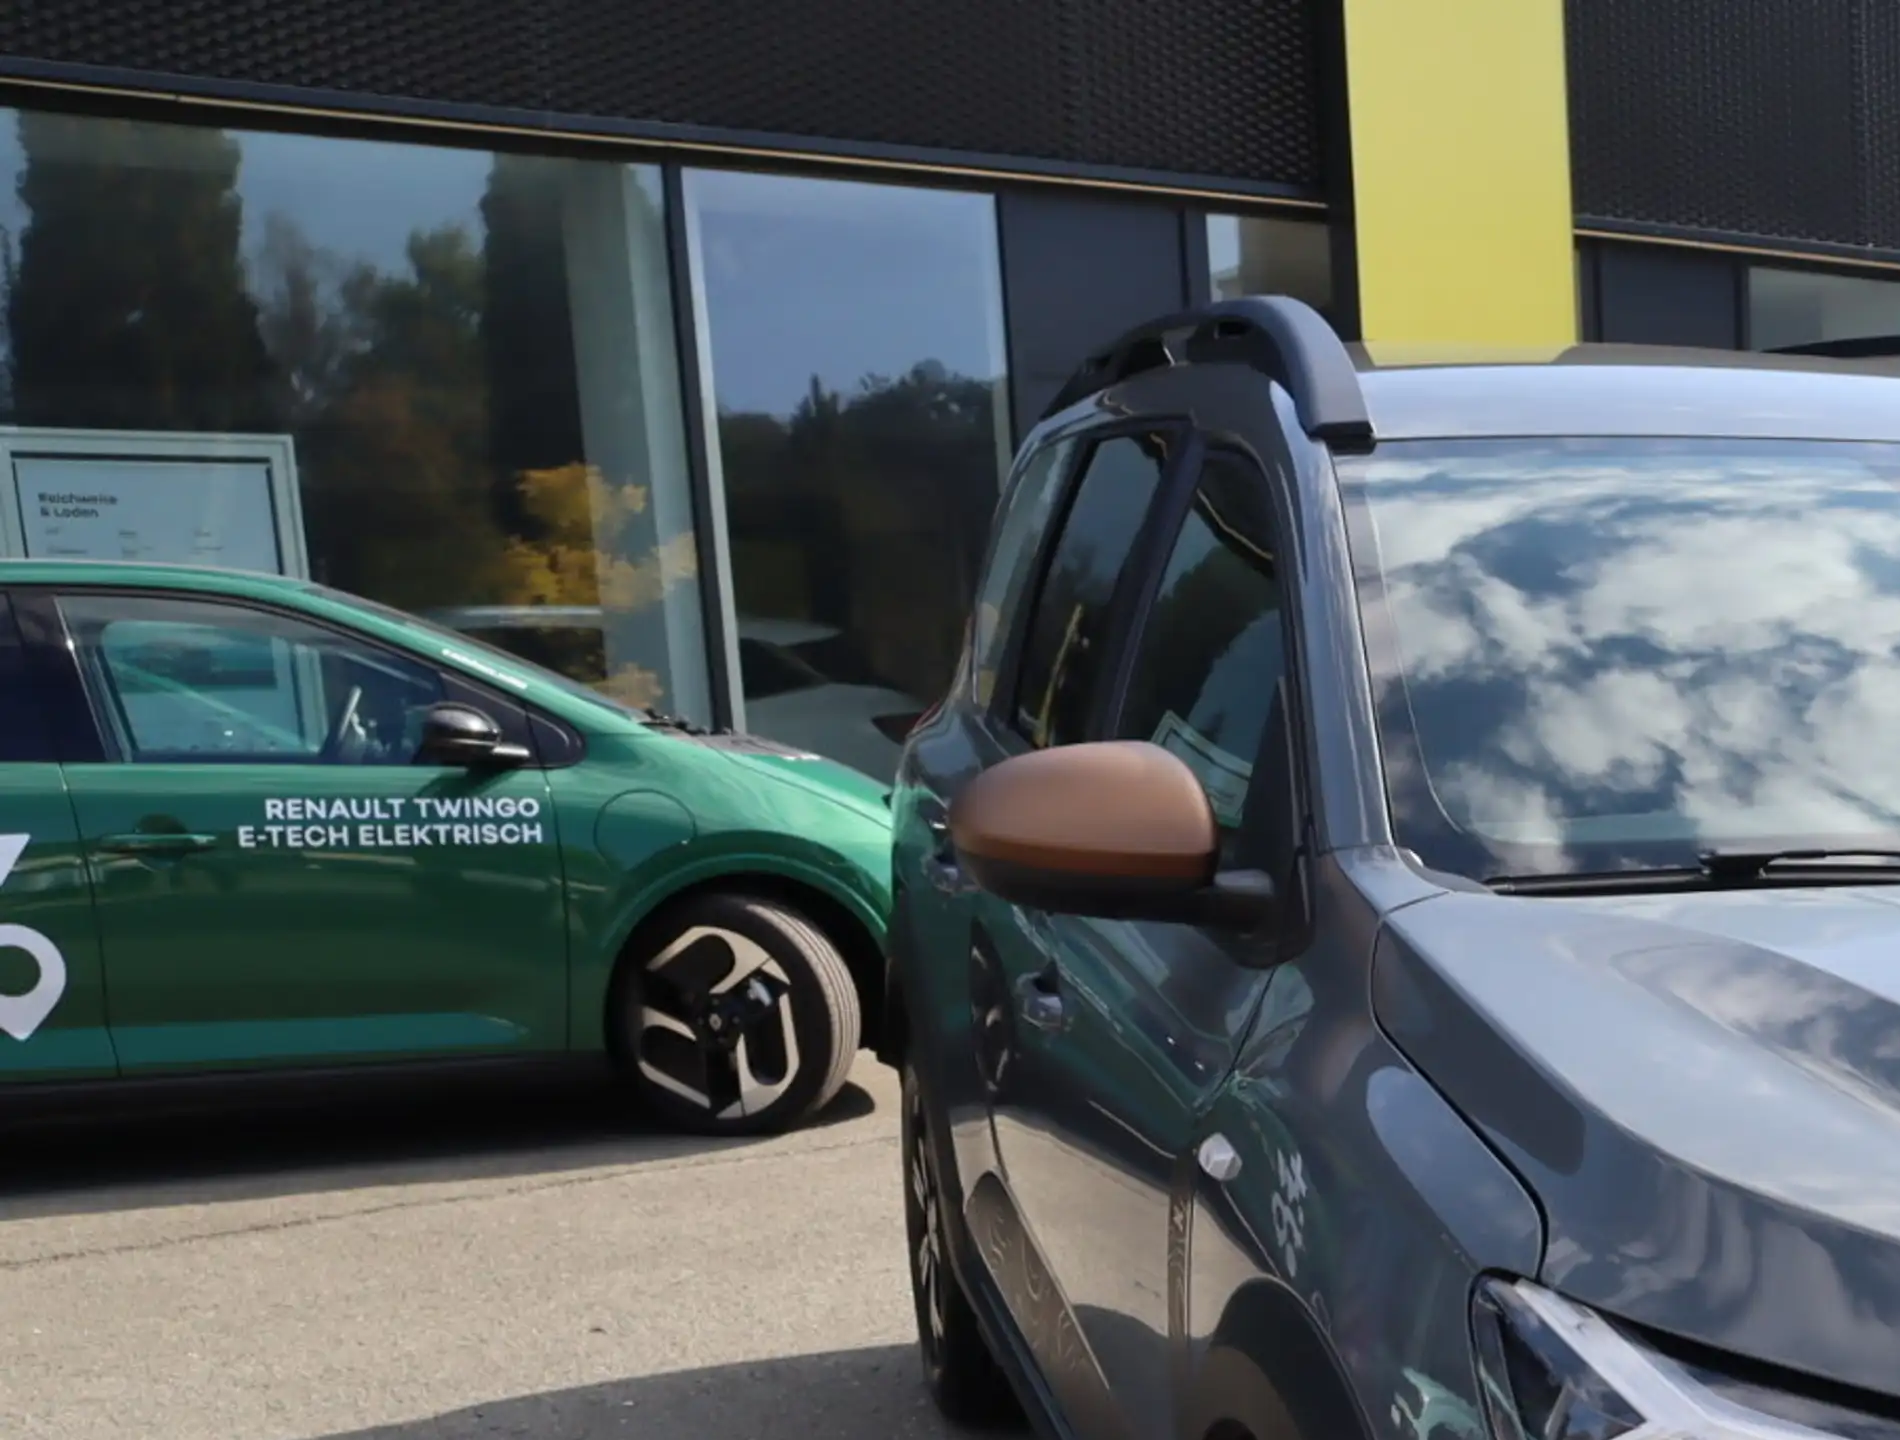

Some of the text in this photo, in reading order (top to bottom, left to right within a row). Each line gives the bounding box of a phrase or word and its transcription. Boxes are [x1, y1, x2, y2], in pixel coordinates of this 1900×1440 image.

[265, 796, 540, 821] RENAULT TWINGO
[237, 822, 544, 848] E-TECH ELEKTRISCH
